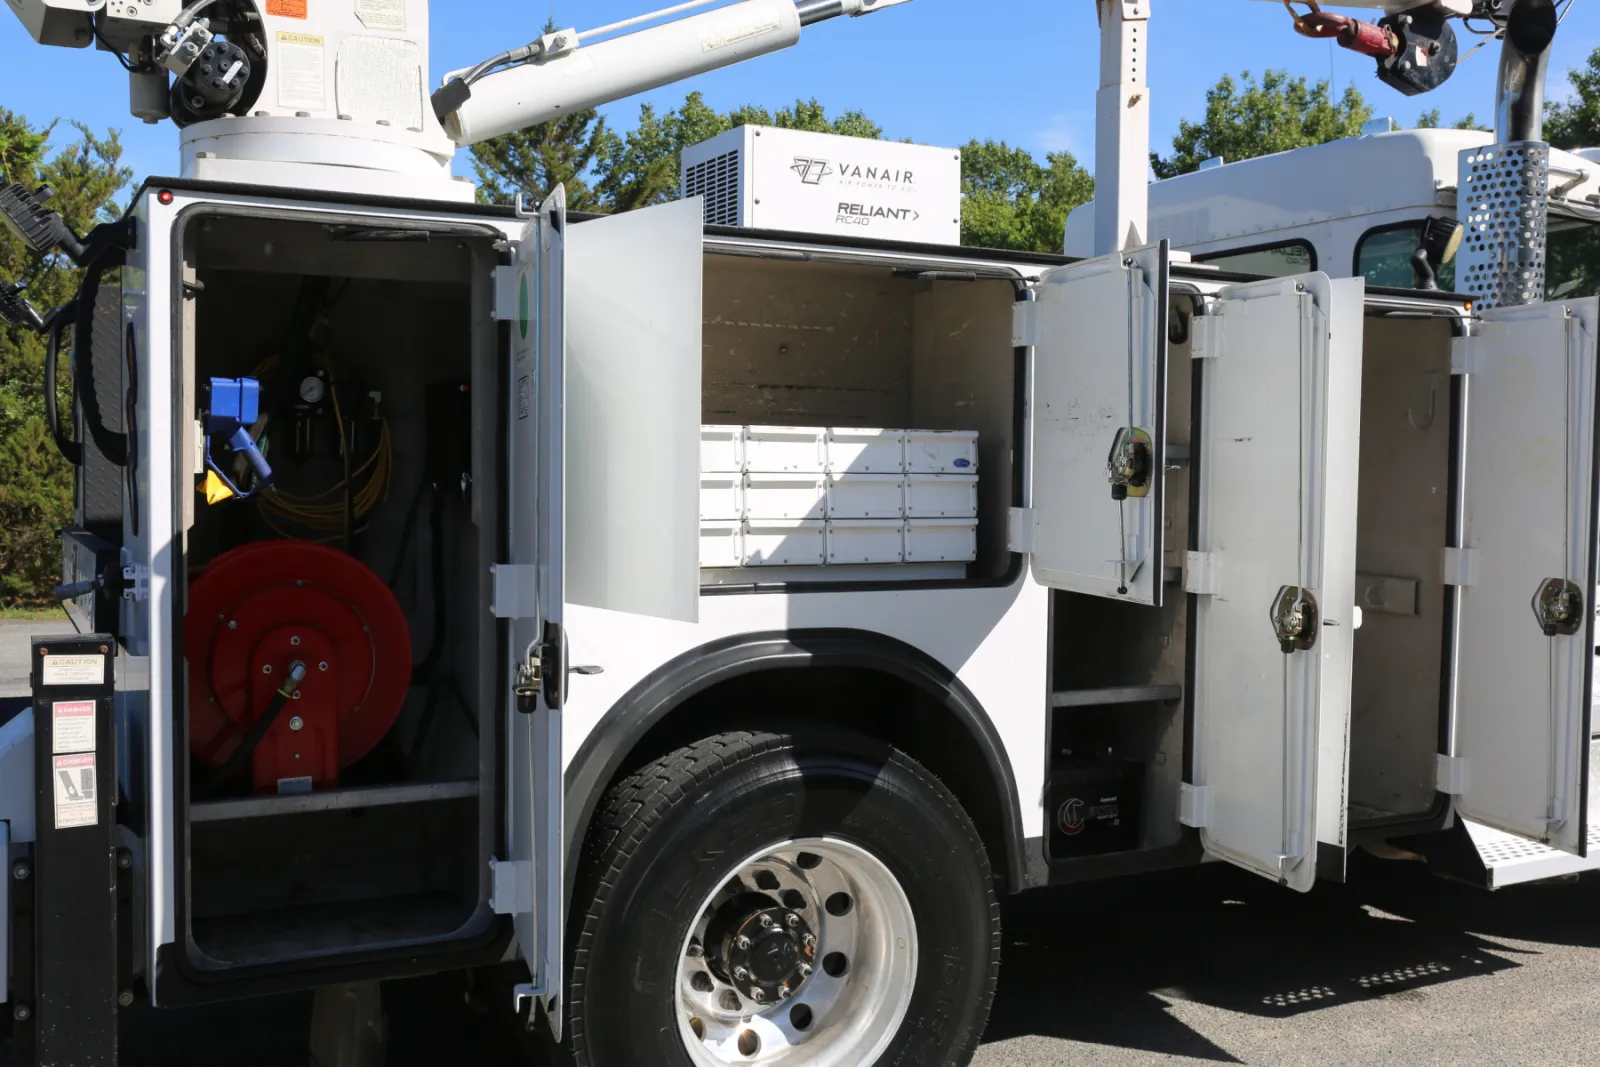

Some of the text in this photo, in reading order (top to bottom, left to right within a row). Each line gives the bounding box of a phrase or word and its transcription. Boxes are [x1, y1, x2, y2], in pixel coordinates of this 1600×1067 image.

[288, 35, 320, 44] CAUTION
[838, 163, 913, 184] VANAIR
[837, 202, 911, 220] RELIANT
[835, 215, 870, 226] RC40
[59, 658, 98, 666] CAUTION
[63, 757, 94, 765] DANGER
